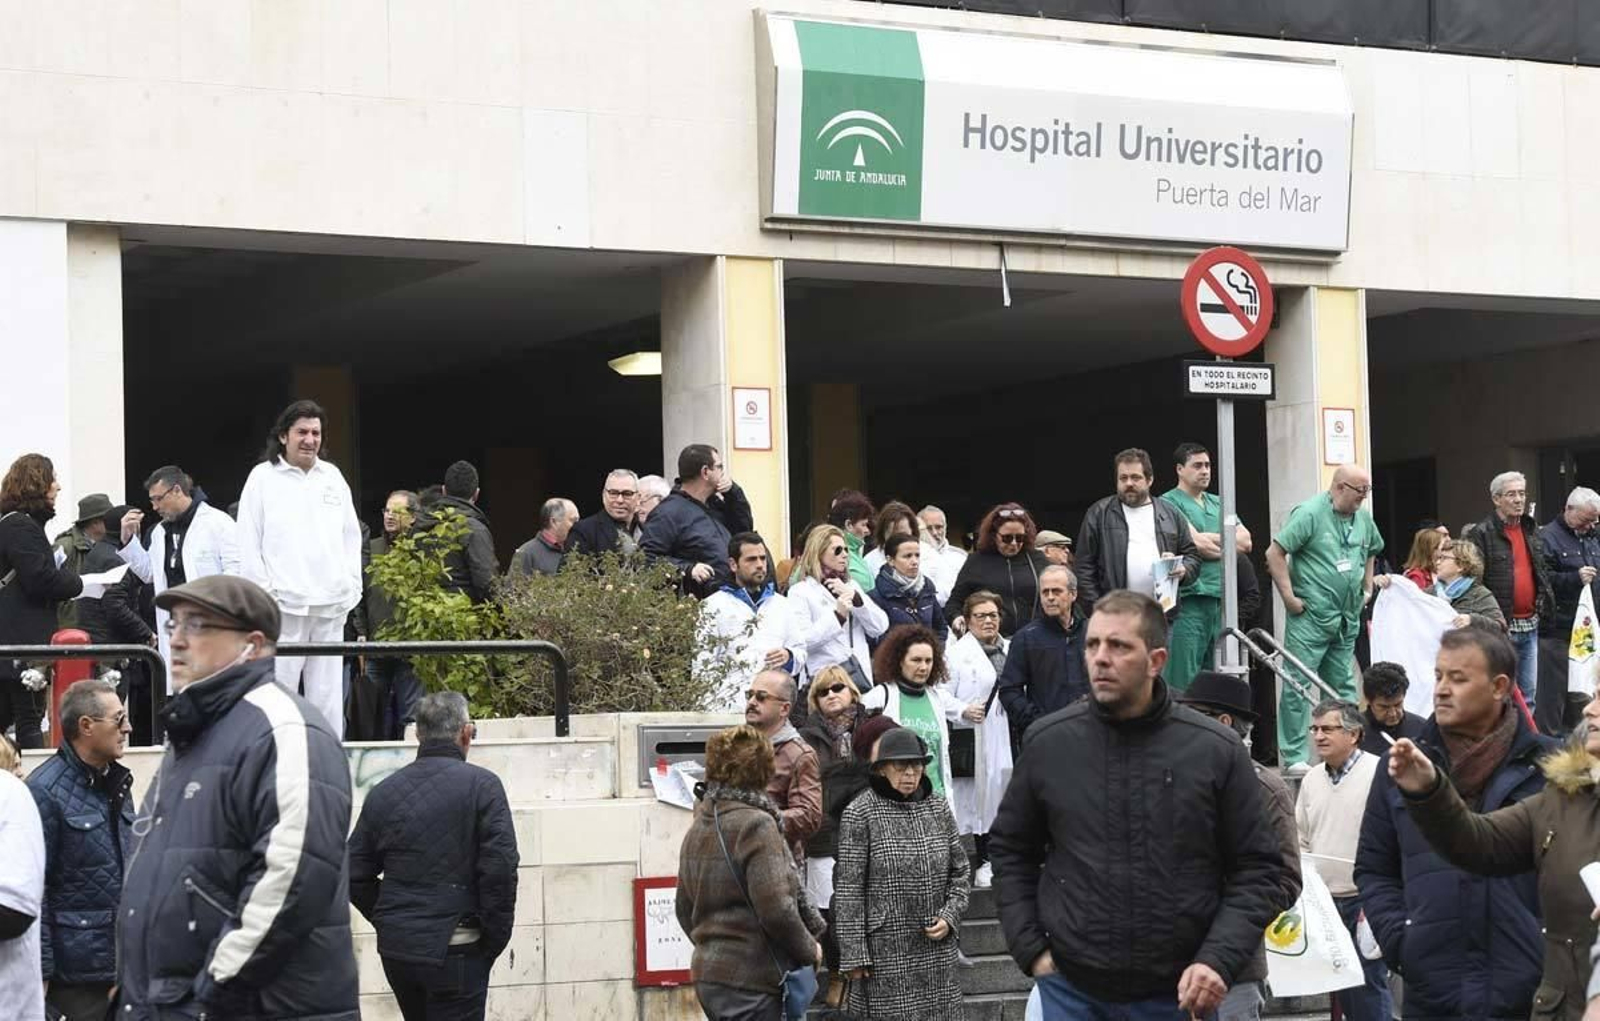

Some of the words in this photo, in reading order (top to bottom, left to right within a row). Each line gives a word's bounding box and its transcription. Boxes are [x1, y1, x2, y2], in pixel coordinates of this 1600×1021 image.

[963, 112, 1102, 163] Hospital
[1119, 123, 1323, 174] Universitario
[814, 168, 841, 182] JUNTA
[846, 170, 856, 183] DE
[860, 171, 906, 186] ANDALUCIA
[1156, 178, 1229, 208] Puerta
[1239, 186, 1270, 210] del
[1280, 187, 1321, 213] Mar
[1191, 370, 1202, 378] EN
[1226, 371, 1235, 379] EL
[1237, 371, 1269, 380] RECINTO
[1204, 381, 1257, 390] HOSPITALARIO
